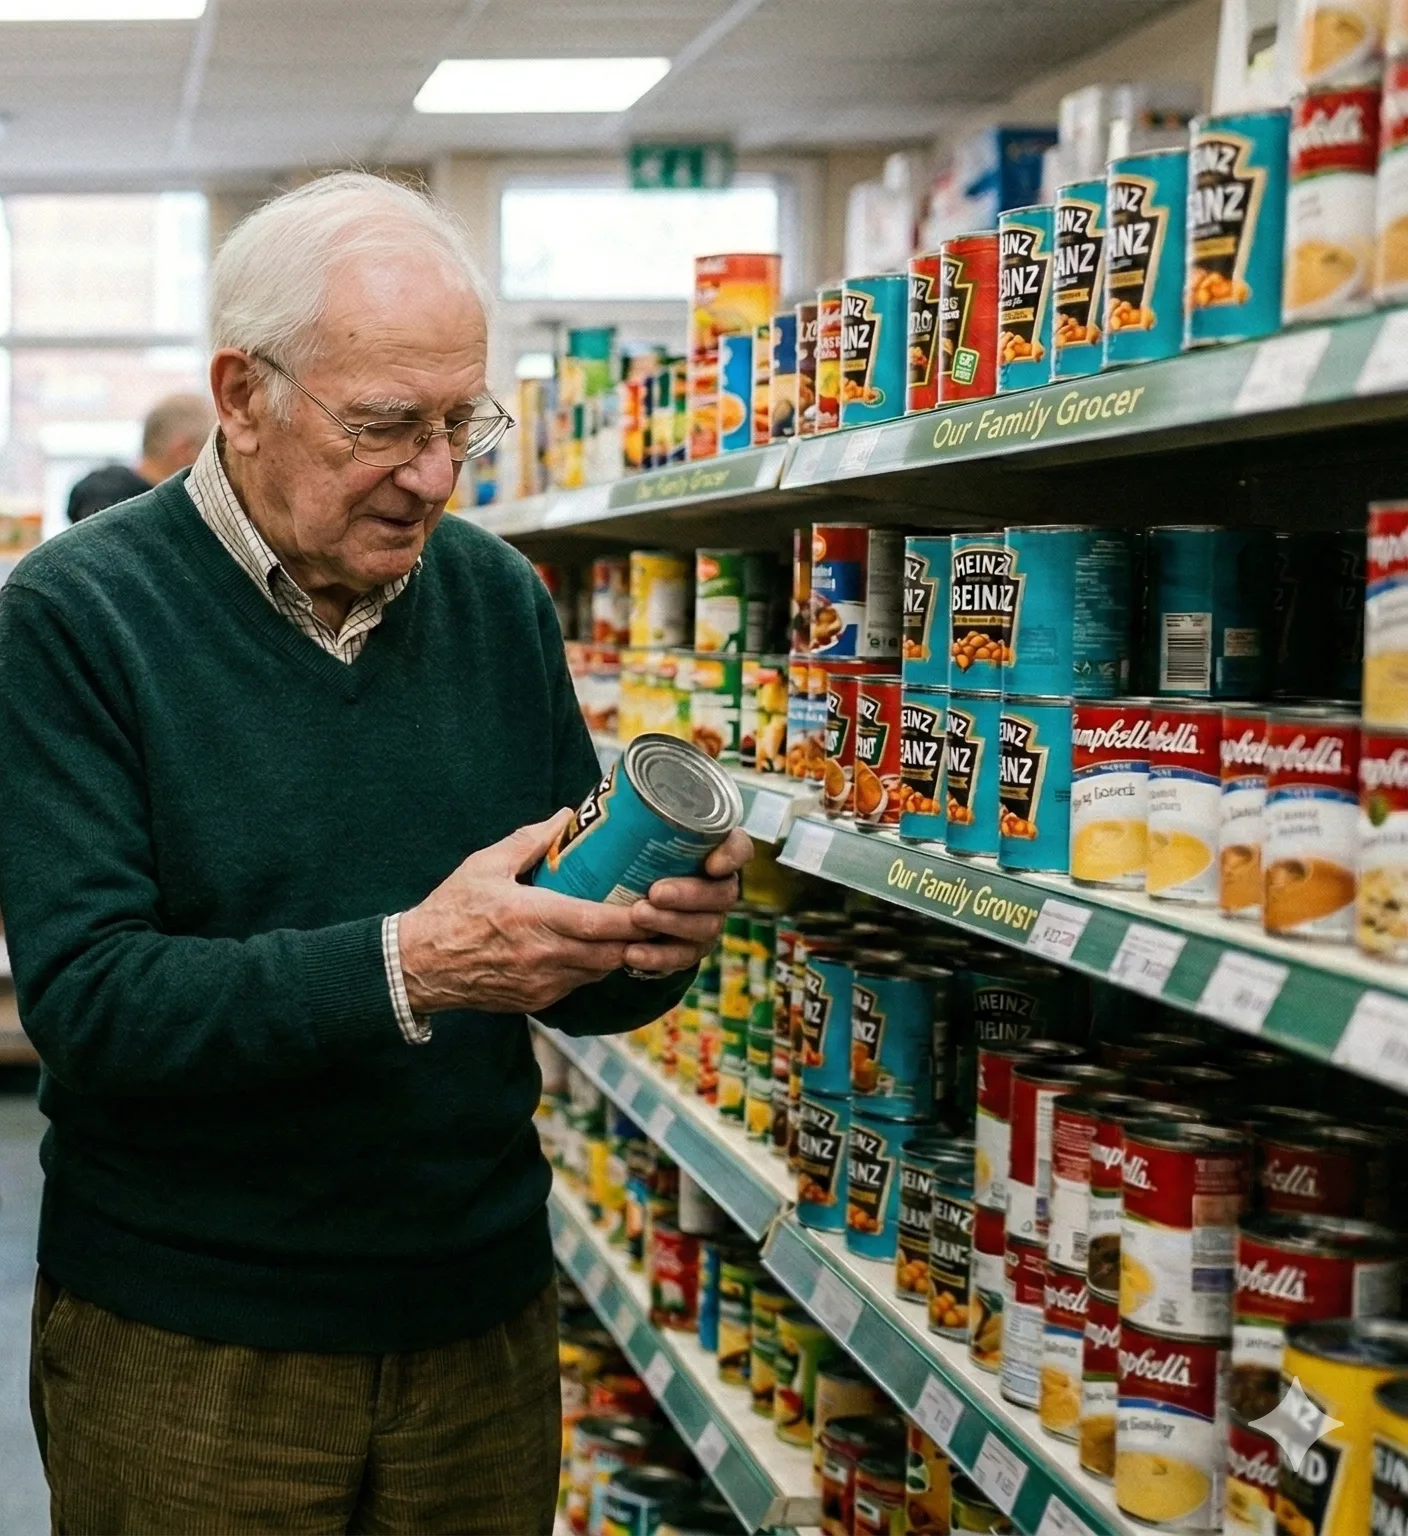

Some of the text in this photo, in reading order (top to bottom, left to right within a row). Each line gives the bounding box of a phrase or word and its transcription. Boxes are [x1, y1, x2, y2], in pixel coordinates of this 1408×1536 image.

[933, 386, 1145, 449] Our Family Grocer
[887, 857, 918, 890] Our
[915, 867, 974, 917] Family
[978, 993, 1032, 1016] HEINZ
